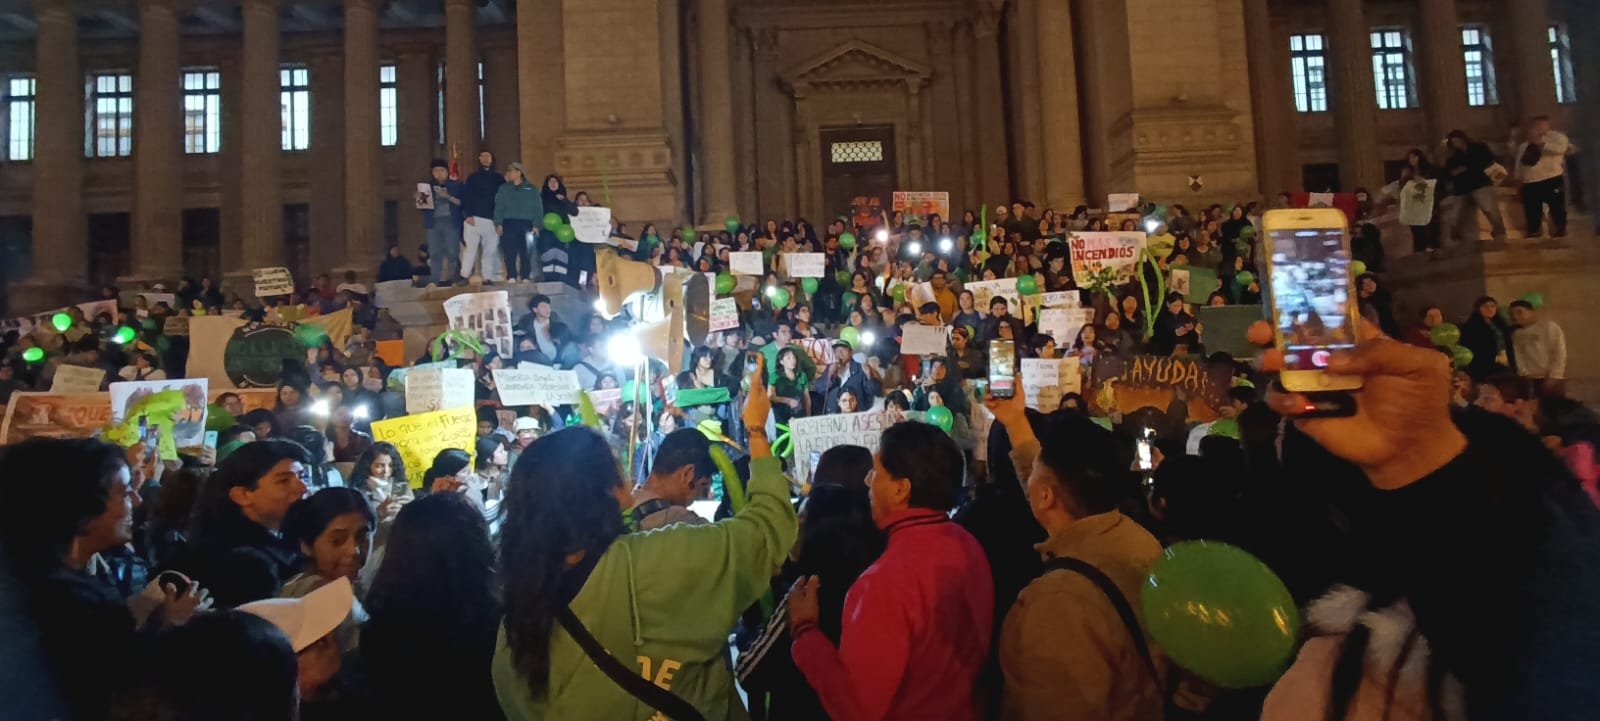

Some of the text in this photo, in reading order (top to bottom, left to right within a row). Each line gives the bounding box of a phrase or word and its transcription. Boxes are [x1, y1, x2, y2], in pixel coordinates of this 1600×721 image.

[894, 193, 906, 201] NO
[1071, 239, 1085, 249] NO
[796, 416, 847, 434] GOBIERNO
